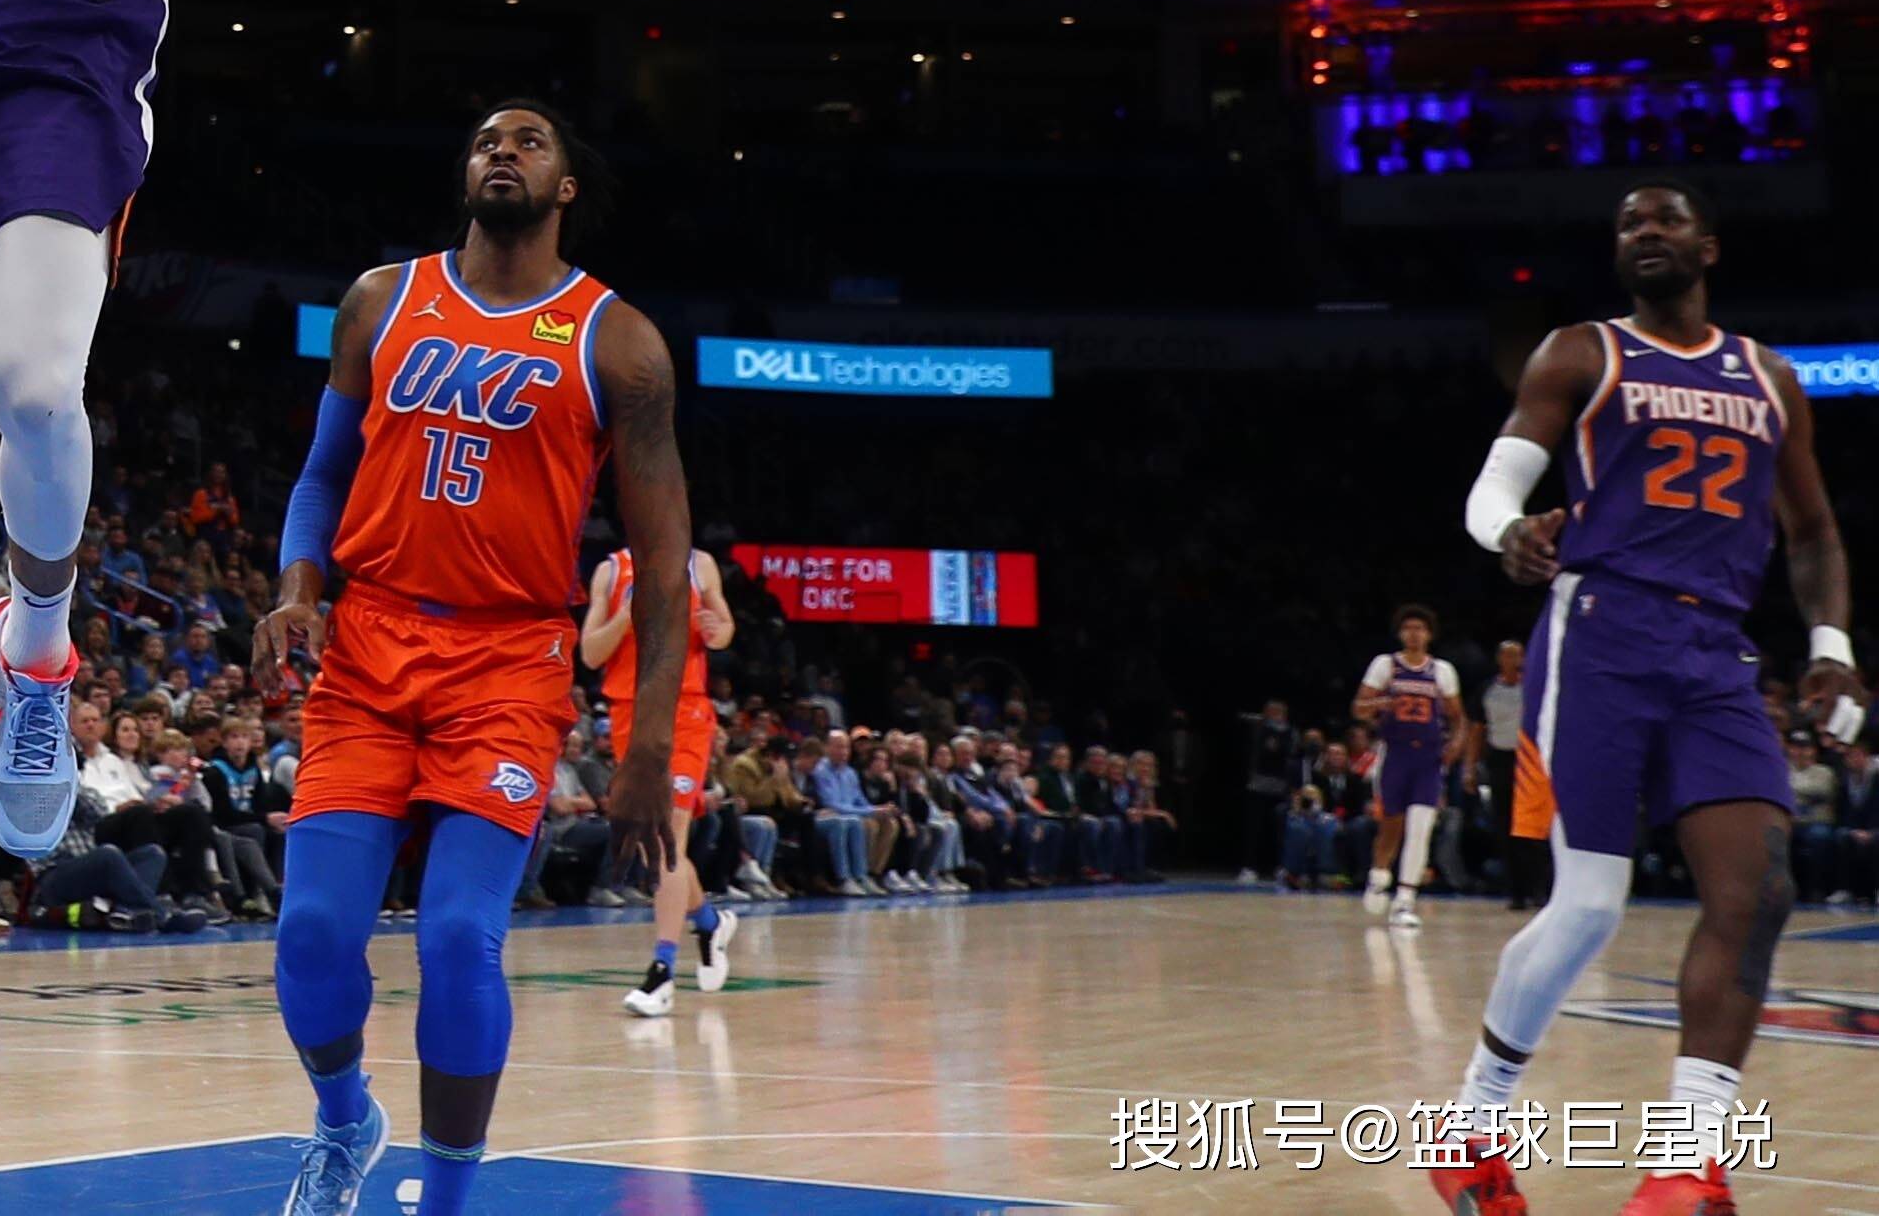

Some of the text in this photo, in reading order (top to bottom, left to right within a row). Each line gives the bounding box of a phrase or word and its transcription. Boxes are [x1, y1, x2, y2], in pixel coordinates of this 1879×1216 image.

[385, 336, 563, 431] OKC
[734, 346, 1012, 396] DELL Technologies
[1618, 381, 1773, 445] PHOENIX
[420, 426, 492, 506] 15
[1643, 427, 1749, 520] 22
[761, 555, 894, 584] MADE FOR
[801, 585, 856, 612] OKC
